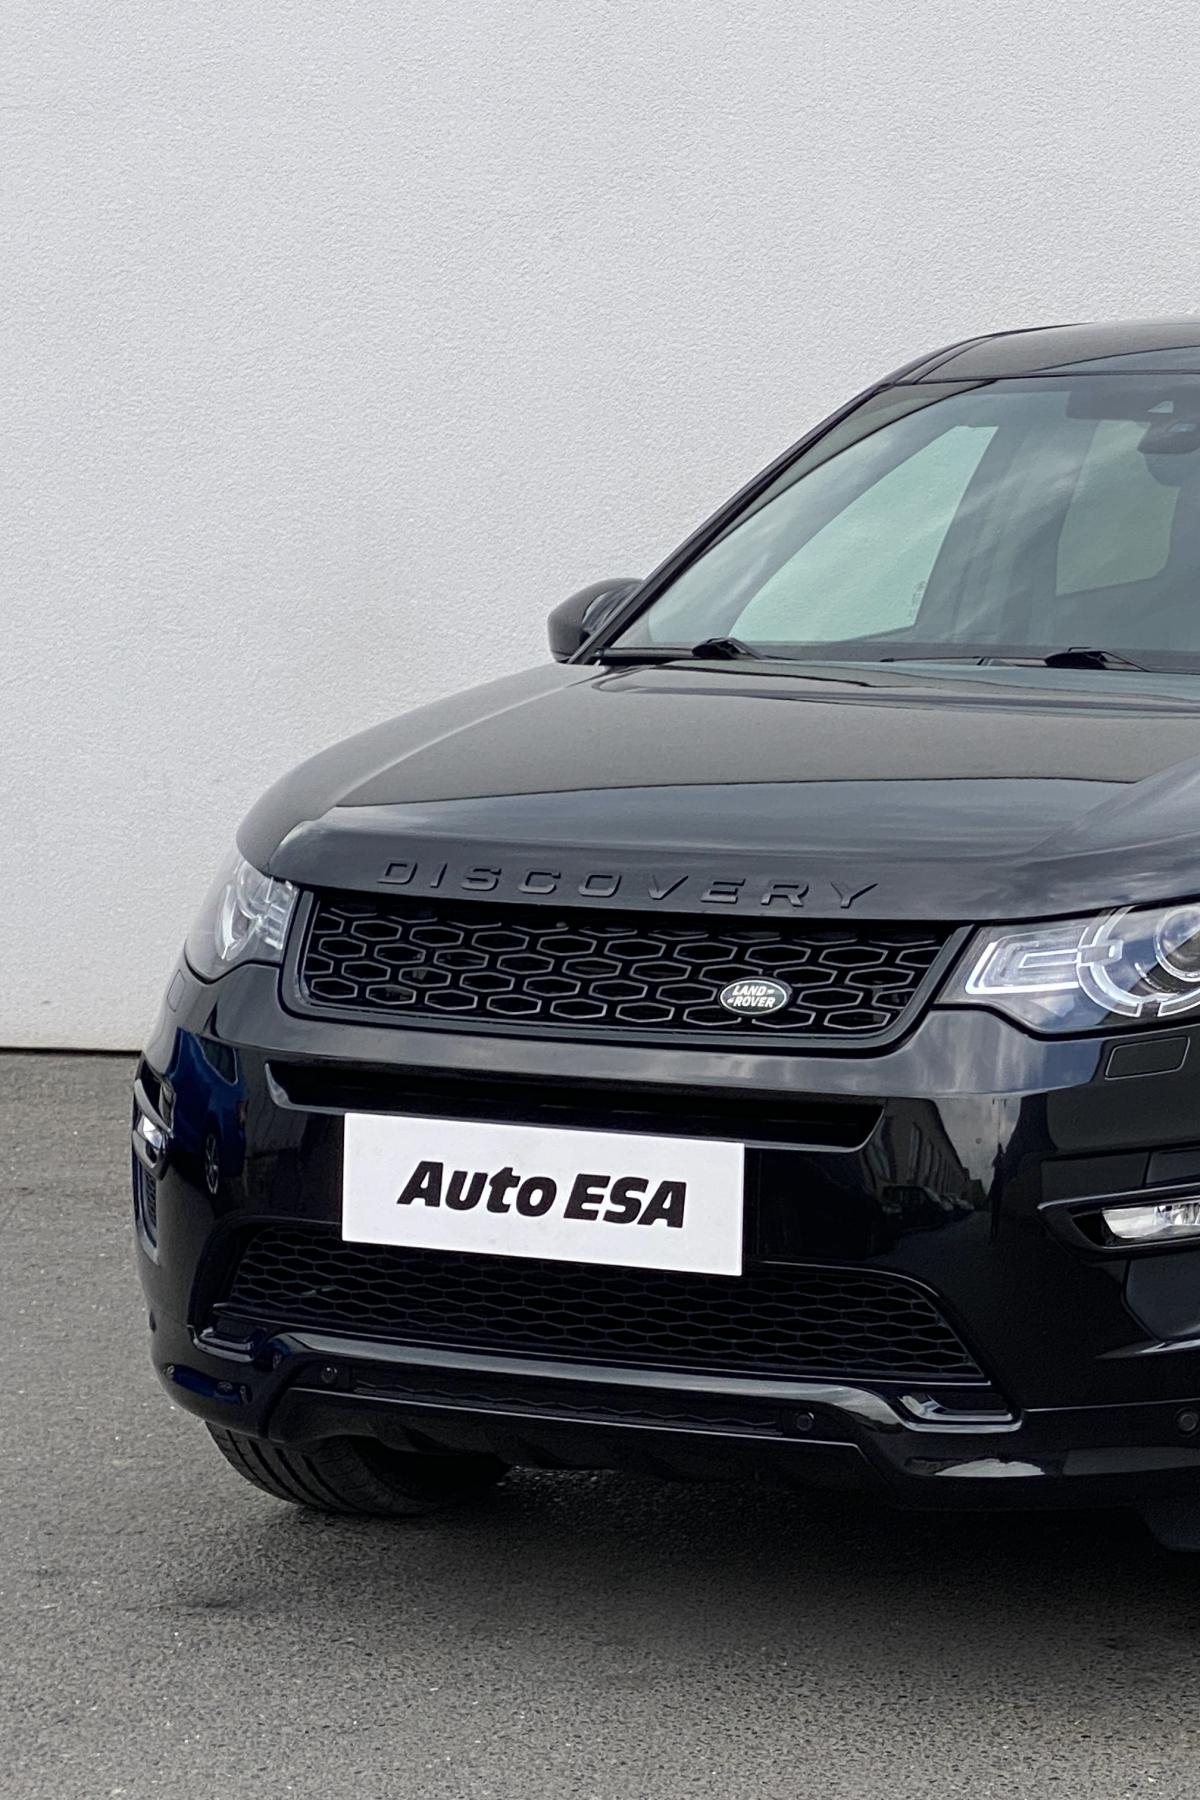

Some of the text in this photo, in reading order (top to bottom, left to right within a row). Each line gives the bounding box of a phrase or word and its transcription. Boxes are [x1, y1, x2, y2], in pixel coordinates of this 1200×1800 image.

[376, 858, 879, 909] DISCOVERY
[396, 1160, 687, 1229] Auto ESA
